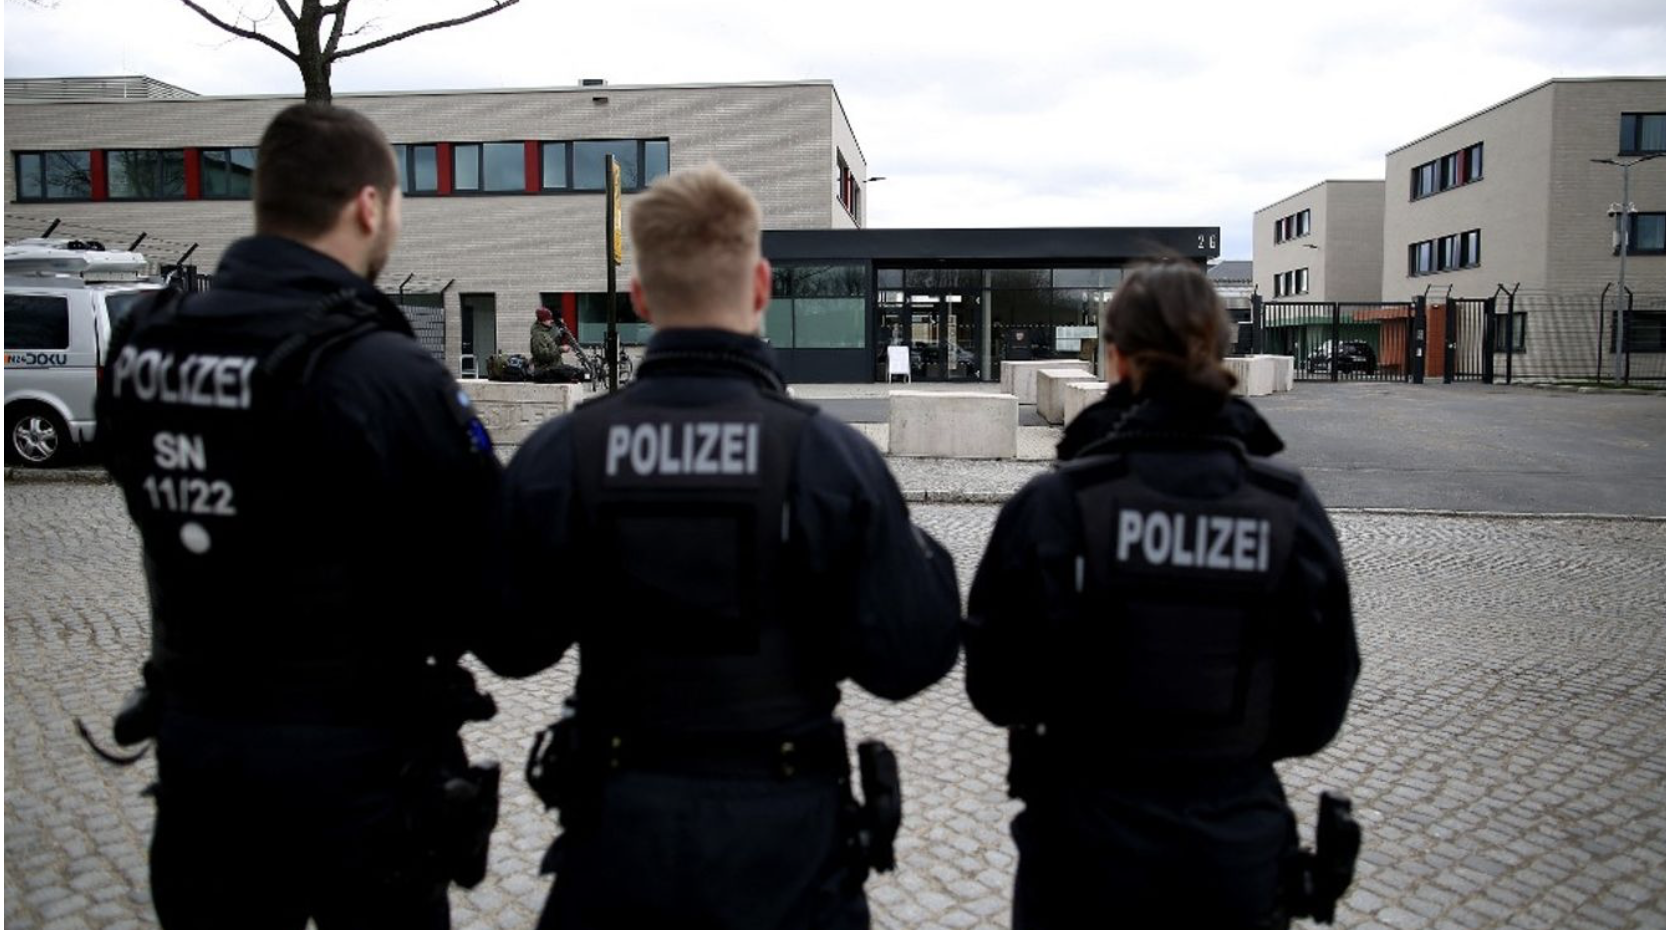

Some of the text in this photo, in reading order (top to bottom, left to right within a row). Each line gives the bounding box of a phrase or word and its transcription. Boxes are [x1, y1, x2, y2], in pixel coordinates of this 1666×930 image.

[113, 345, 257, 409] POLIZEI
[153, 431, 207, 471] SN
[605, 422, 759, 476] POLIZEI
[143, 475, 237, 516] 11/22
[1116, 508, 1271, 572] POLIZEI
